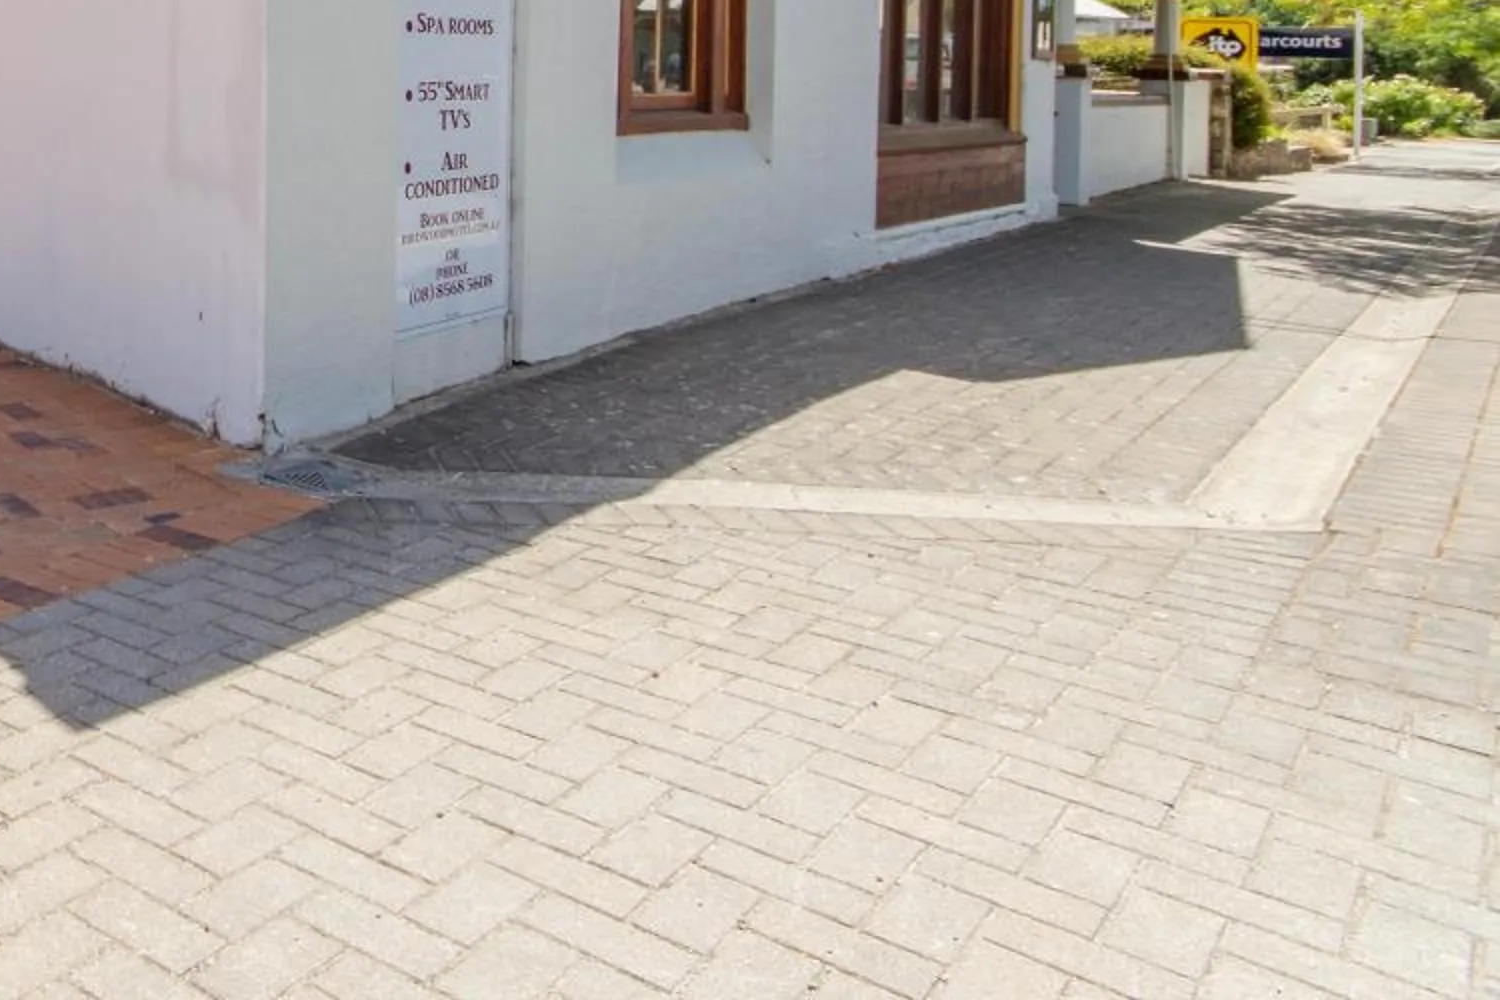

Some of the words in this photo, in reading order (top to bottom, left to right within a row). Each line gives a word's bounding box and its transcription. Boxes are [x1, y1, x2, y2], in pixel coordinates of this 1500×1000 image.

[417, 13, 444, 36] SPA
[449, 17, 494, 36] ROOMS
[1261, 34, 1343, 49] arcourts
[445, 81, 490, 102] SMART
[441, 152, 468, 171] AIR
[405, 173, 500, 200] CONDITIONED
[420, 212, 449, 228] BOOK
[452, 207, 485, 223] ONLINE
